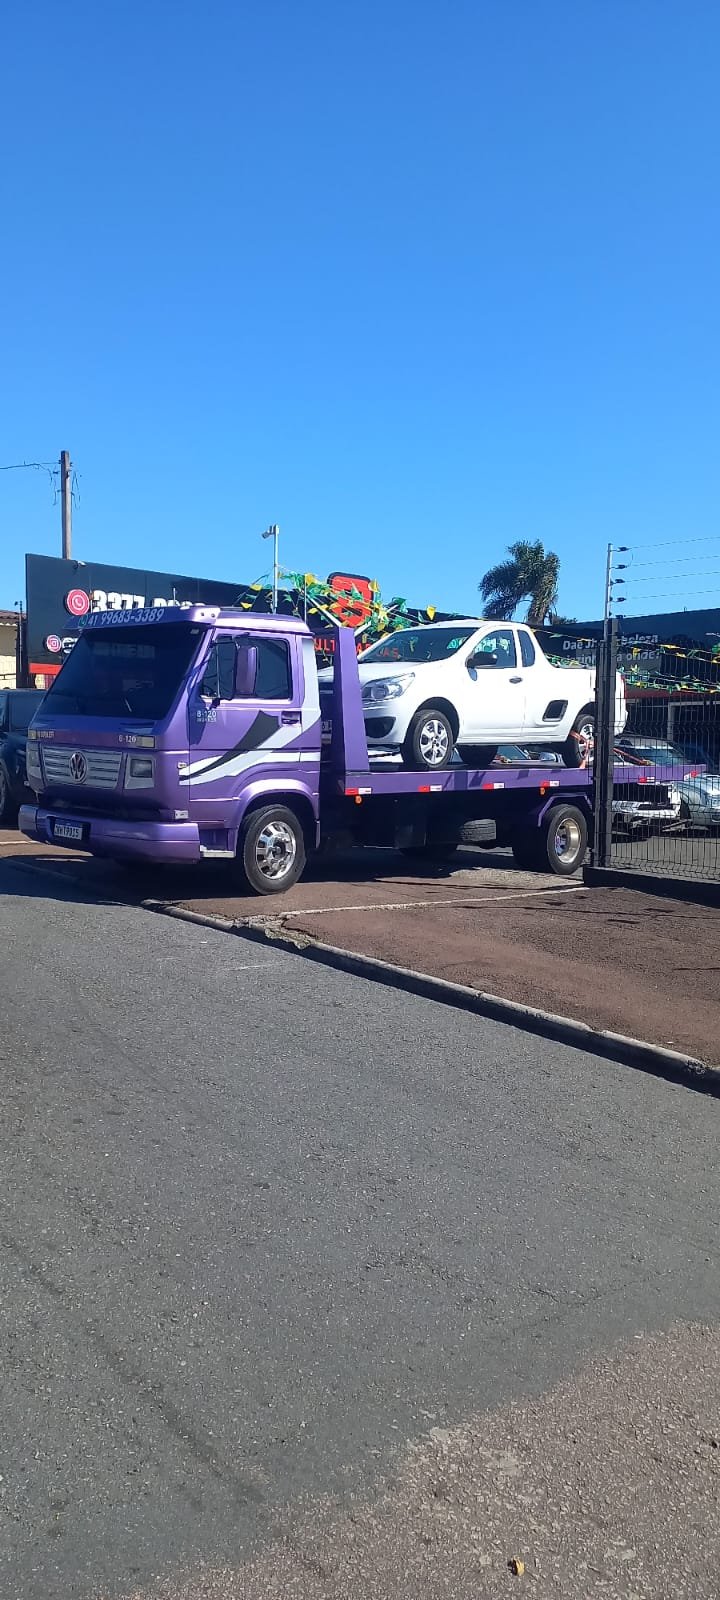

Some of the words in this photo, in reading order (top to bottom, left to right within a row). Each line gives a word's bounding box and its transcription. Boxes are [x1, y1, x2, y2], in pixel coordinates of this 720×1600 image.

[88, 615, 98, 626] 41
[101, 609, 164, 625] 99683-3389
[563, 640, 583, 650] Dae
